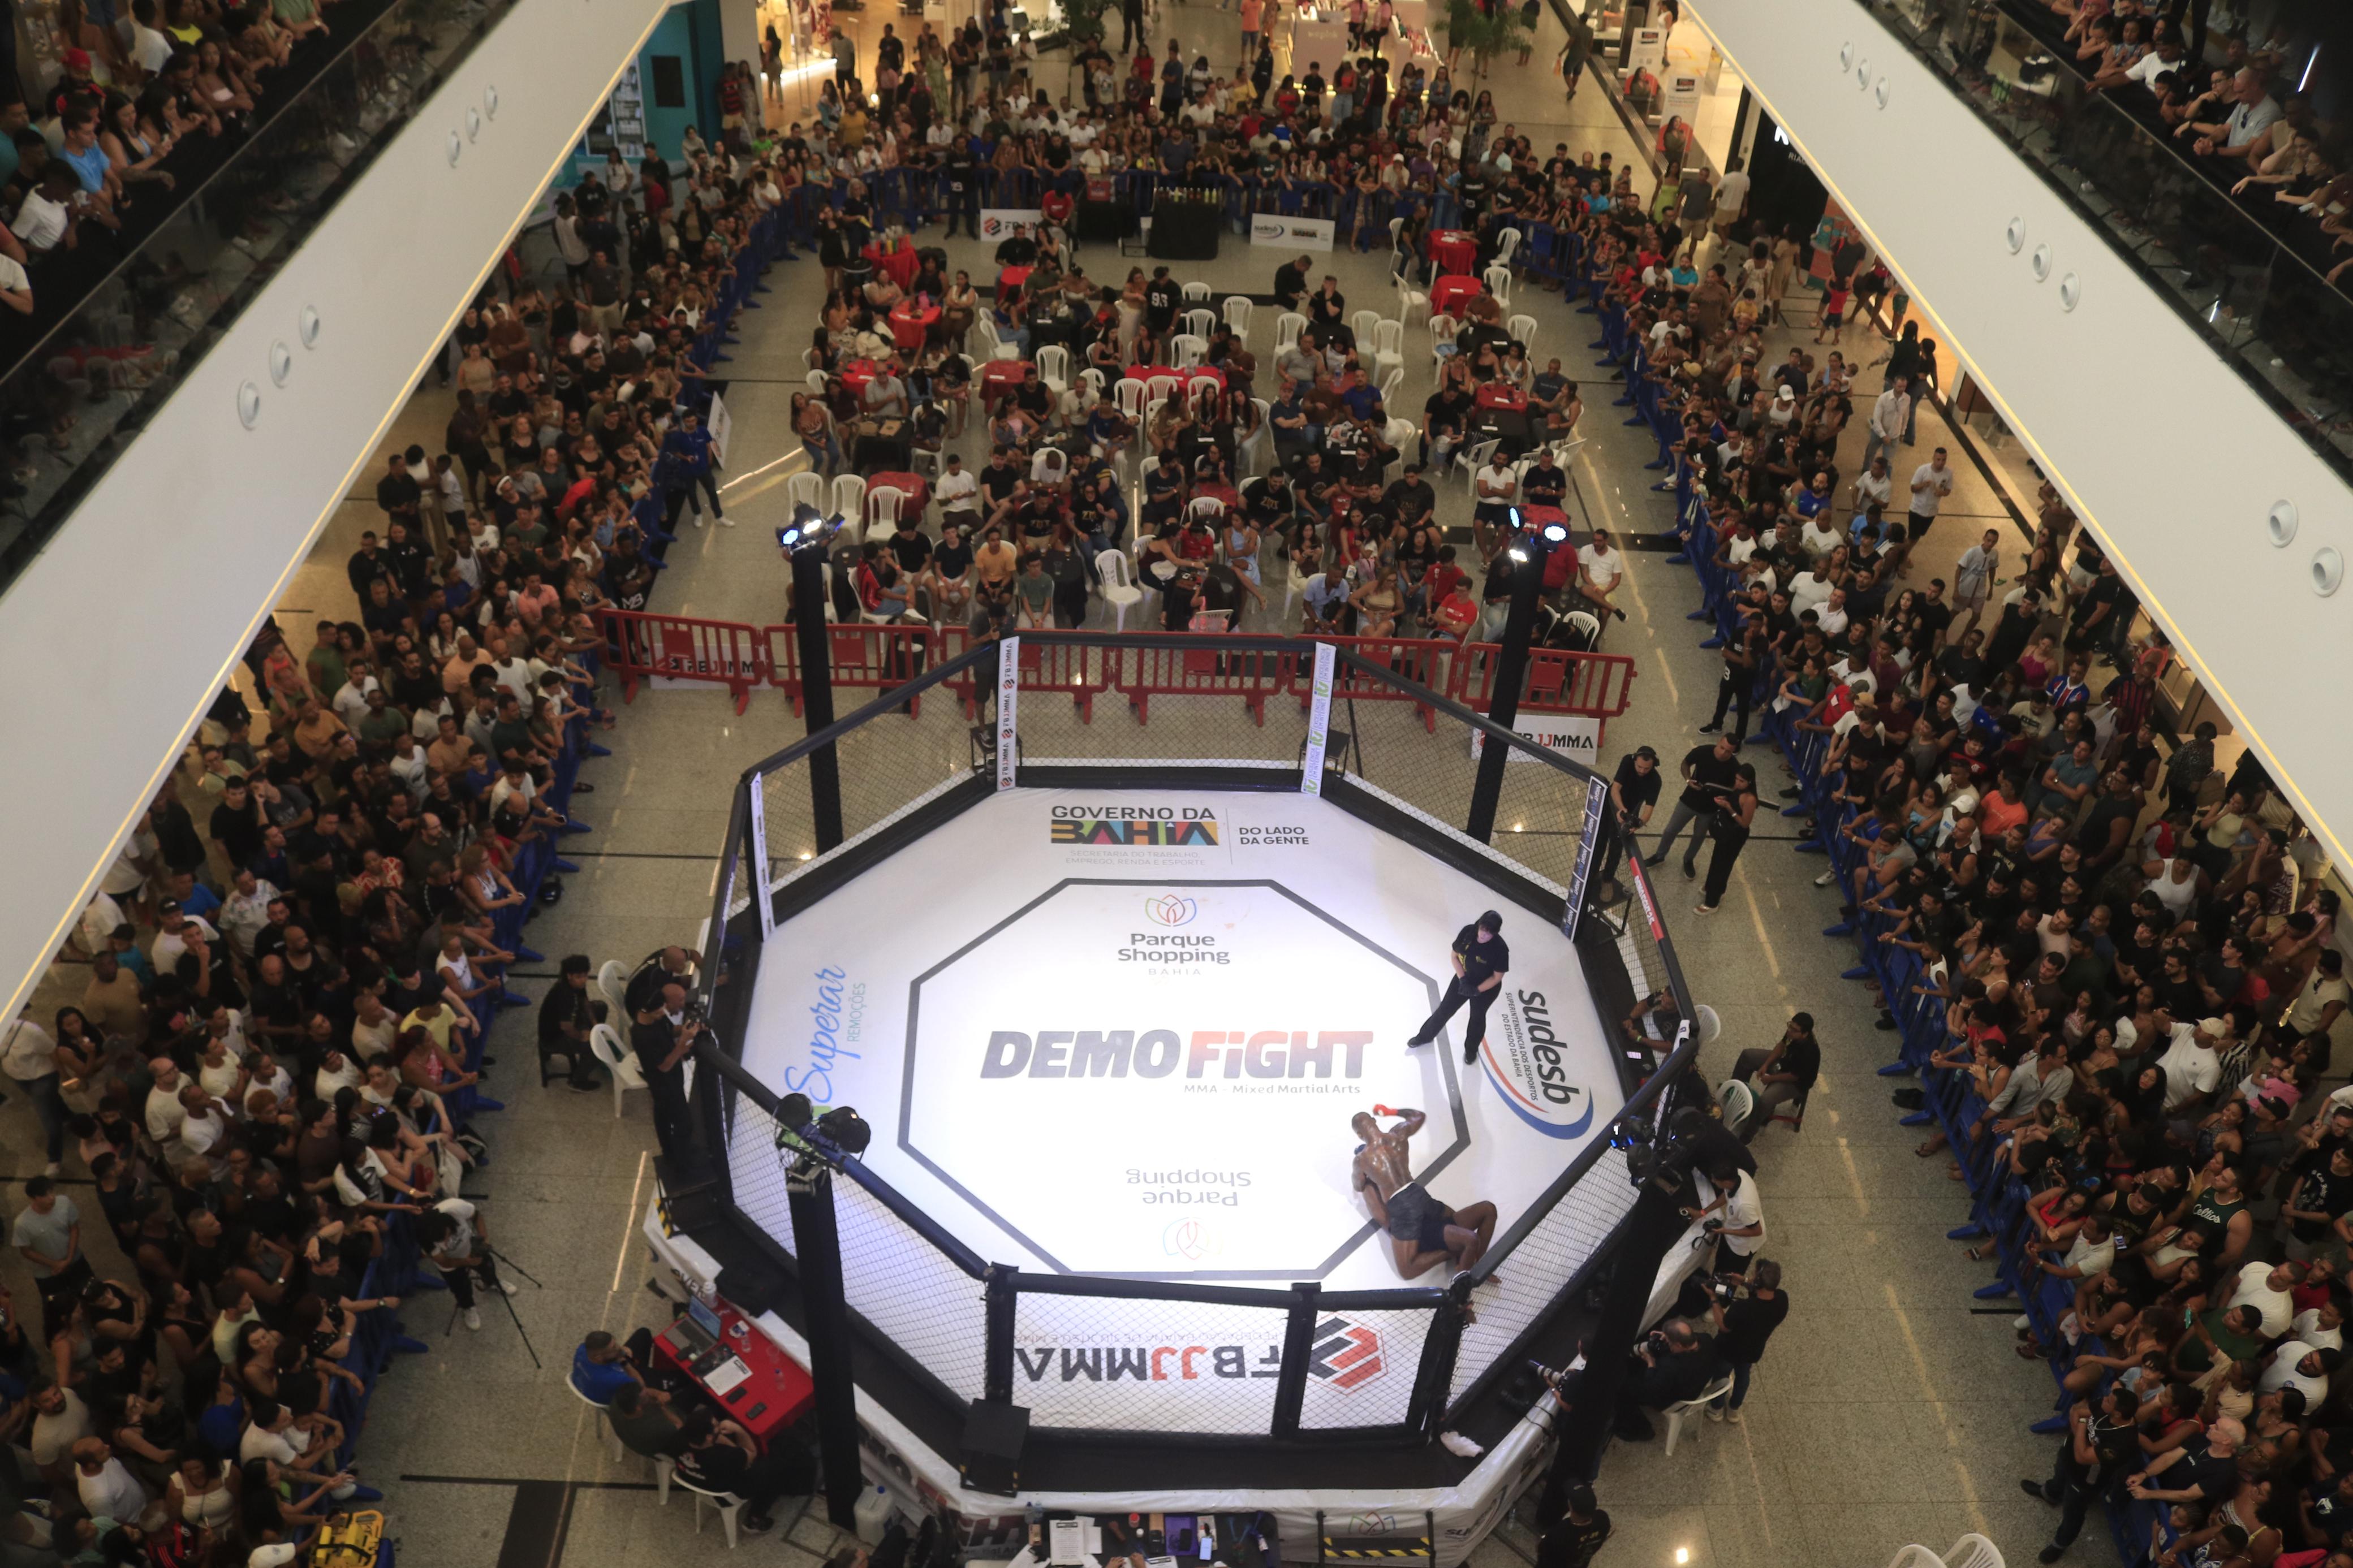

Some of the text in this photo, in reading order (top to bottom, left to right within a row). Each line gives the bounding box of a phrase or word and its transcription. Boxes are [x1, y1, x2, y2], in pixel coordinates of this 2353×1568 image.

[1051, 806, 1216, 820] GOVERNO DA
[1051, 819, 1219, 845] BAHIA
[1240, 836, 1309, 845] DA GENTE
[1131, 933, 1215, 948] Parque
[1118, 948, 1231, 964] Shopping
[847, 983, 867, 1042] REMOÇÕES
[785, 965, 861, 1103] Superar
[1502, 1014, 1523, 1077] DO ESTADO DA BAHIA
[980, 1029, 1182, 1079] DEMO
[1505, 992, 1525, 1050] SUPERINTENDÊNCIA
[1524, 1064, 1538, 1101] DESPORTOS
[1518, 989, 1580, 1104] sudesb
[1184, 1085, 1218, 1093] MMA
[1232, 1084, 1274, 1094] Mixed
[1278, 1084, 1329, 1094] Martial
[1332, 1085, 1361, 1094] Arts
[1126, 1168, 1252, 1188] Shopping
[1142, 1189, 1238, 1206] Parque
[2193, 1204, 2221, 1223] Celtics
[1014, 1345, 1281, 1381] FBJJMMA
